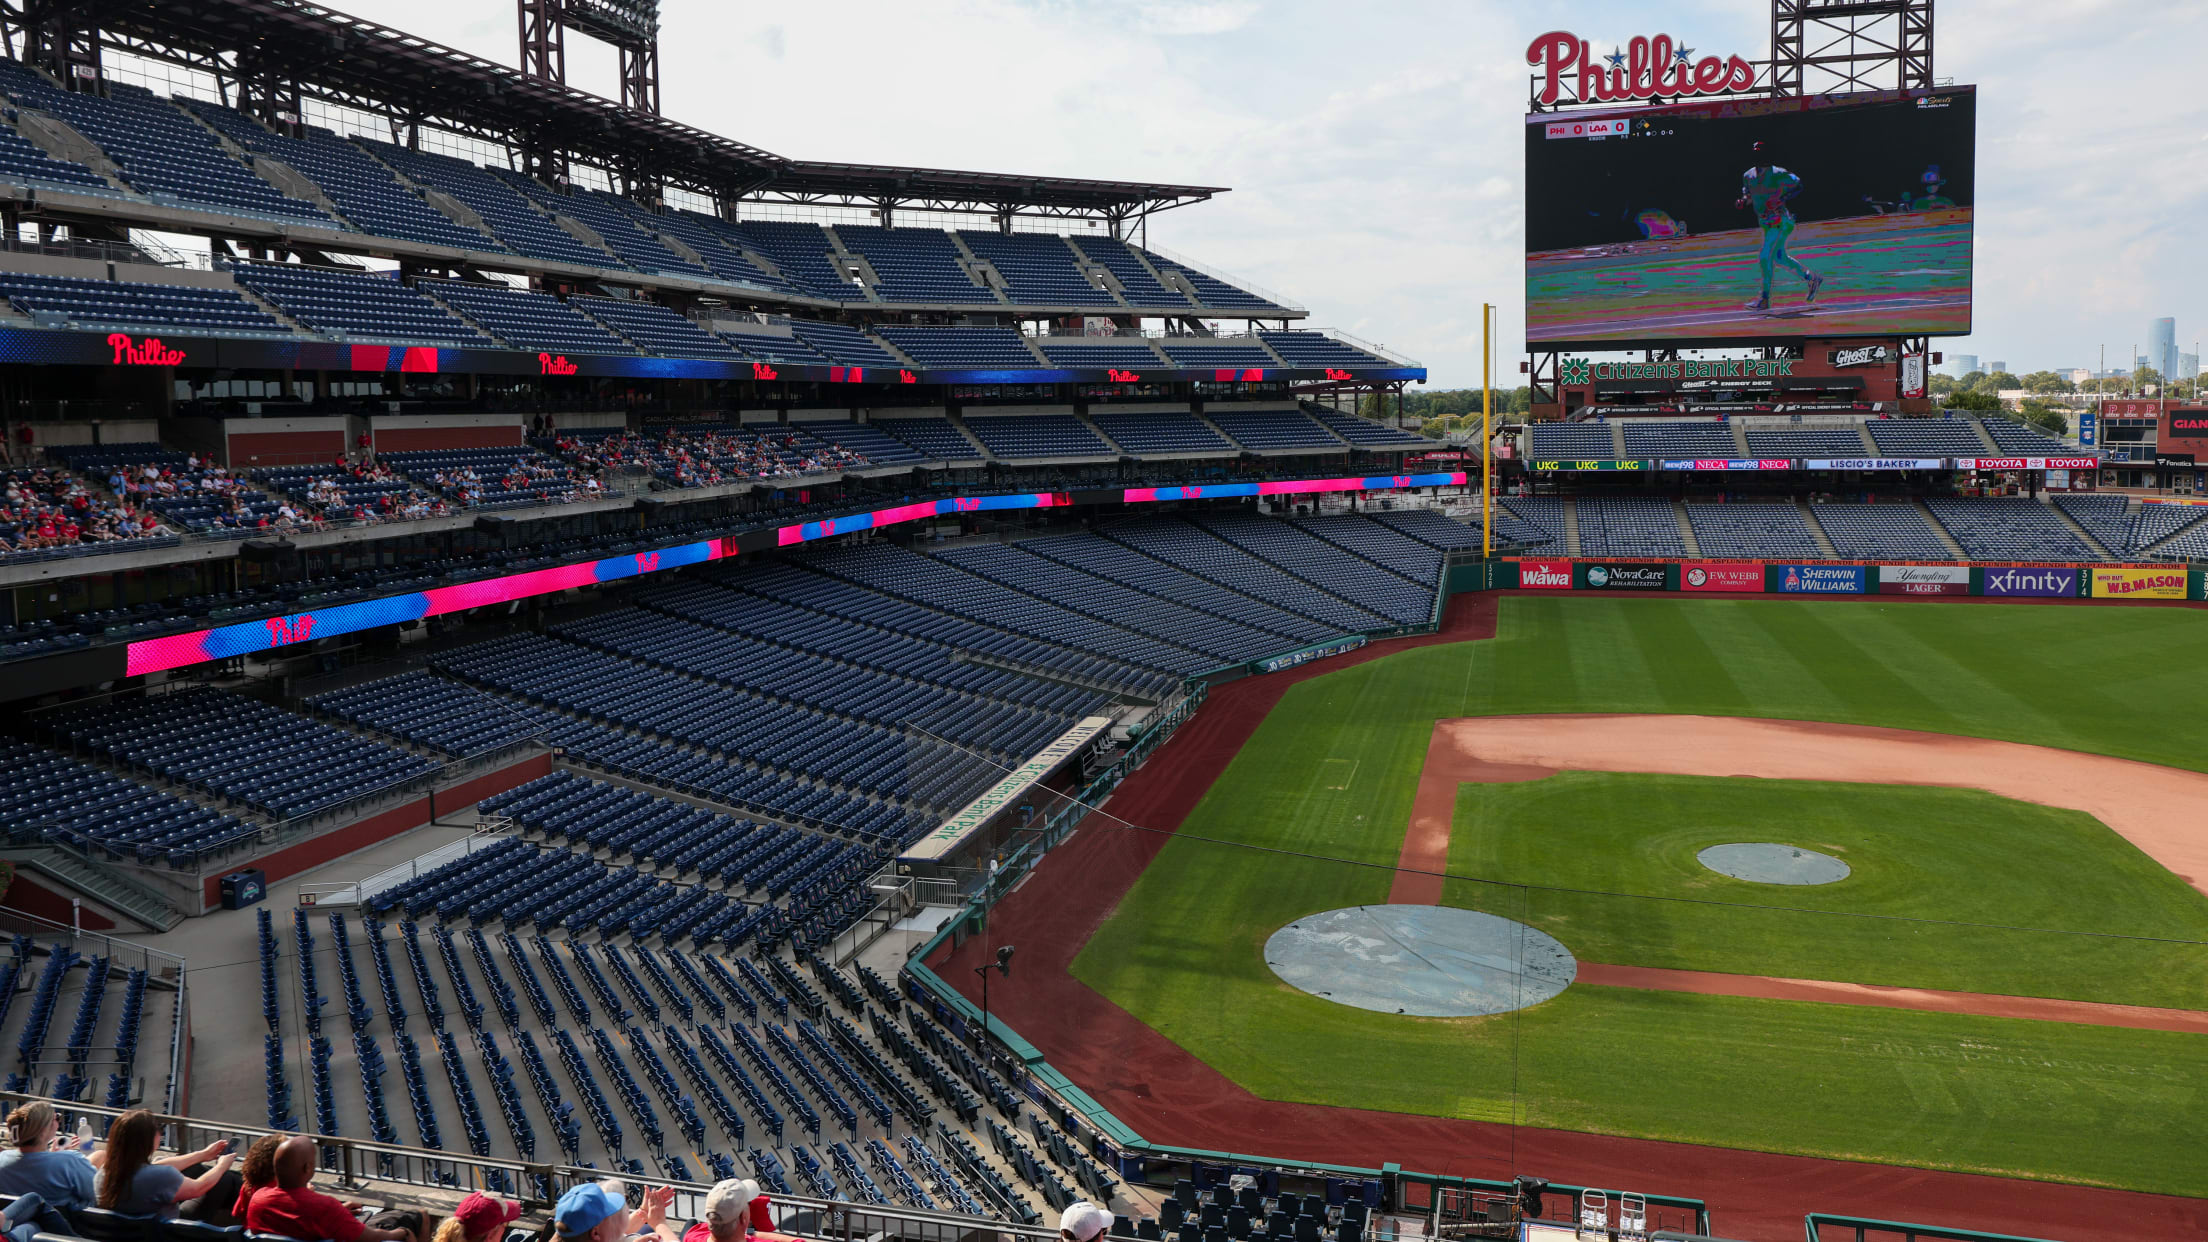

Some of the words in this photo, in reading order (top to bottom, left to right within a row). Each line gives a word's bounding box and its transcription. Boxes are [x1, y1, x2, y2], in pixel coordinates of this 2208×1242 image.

[1526, 31, 1755, 104] Phillies
[1550, 127, 1565, 135] PHI
[1573, 125, 1583, 134] 0
[1589, 125, 1608, 133] LAA
[1615, 122, 1625, 132] 0
[107, 333, 187, 366] Phillies
[1836, 346, 1876, 366] GHOST
[1595, 361, 1680, 379] Citizens
[1685, 359, 1740, 378] Bank
[1744, 357, 1793, 376] Park
[1108, 369, 1140, 382] Phillies
[2110, 405, 2117, 414] P
[2128, 405, 2136, 414] P
[2147, 404, 2155, 413] P
[1537, 461, 1559, 470] UKG
[1576, 461, 1598, 470] UKG
[1616, 461, 1639, 470] UKG
[1697, 461, 1725, 469] NECA
[1762, 461, 1789, 469] NECA
[1830, 460, 1873, 468] LISCIO'S
[1877, 460, 1918, 468] BAKERY
[1979, 459, 2023, 468] TOYOTA
[2050, 459, 2094, 467] TOYOTA
[1522, 571, 1569, 585] Wawa
[1609, 568, 1664, 579] NovaCare
[1729, 572, 1759, 580] WEBB
[1802, 568, 1856, 580] SHERWIN
[1897, 568, 1951, 582] Yuengling
[1990, 570, 2071, 593] xfinity
[1906, 584, 1941, 592] LAGER
[1040, 726, 1098, 758] WELCOME
[987, 769, 1039, 799] Citizens
[960, 799, 1001, 821] Bank
[930, 820, 975, 841] Park
